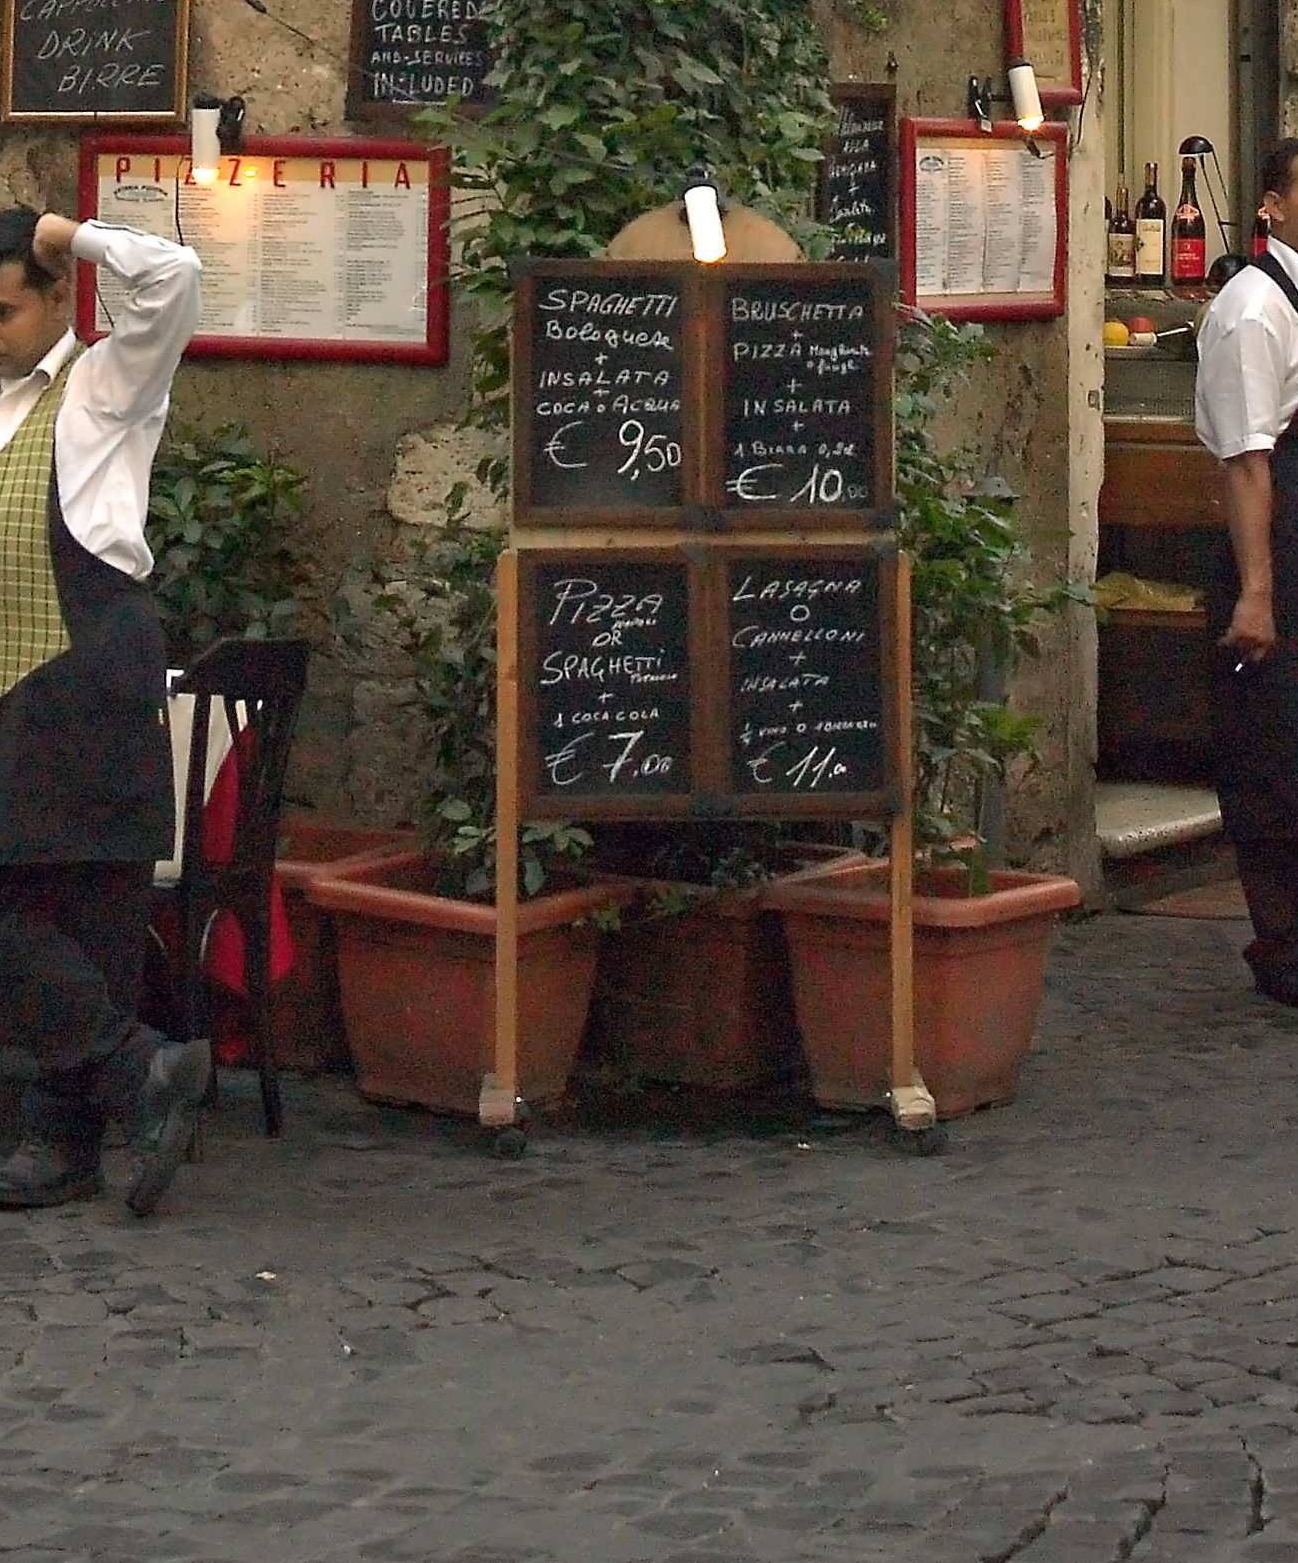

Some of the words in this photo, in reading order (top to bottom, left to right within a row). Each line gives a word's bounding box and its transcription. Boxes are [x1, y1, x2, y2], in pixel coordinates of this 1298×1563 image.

[374, 23, 468, 45] TABLES
[58, 62, 165, 94] BIRRE
[539, 289, 680, 320] SPAGHETTI
[731, 297, 865, 323] BRUSCHETTA
[733, 342, 803, 362] PIZZA
[539, 369, 671, 389] INSALATA
[535, 398, 591, 416] COCA
[743, 398, 852, 418] INSALATA
[617, 418, 682, 482] 9,50
[732, 575, 863, 602] LASAGNA
[591, 630, 625, 648] OR
[732, 624, 866, 650] CANNELLONI
